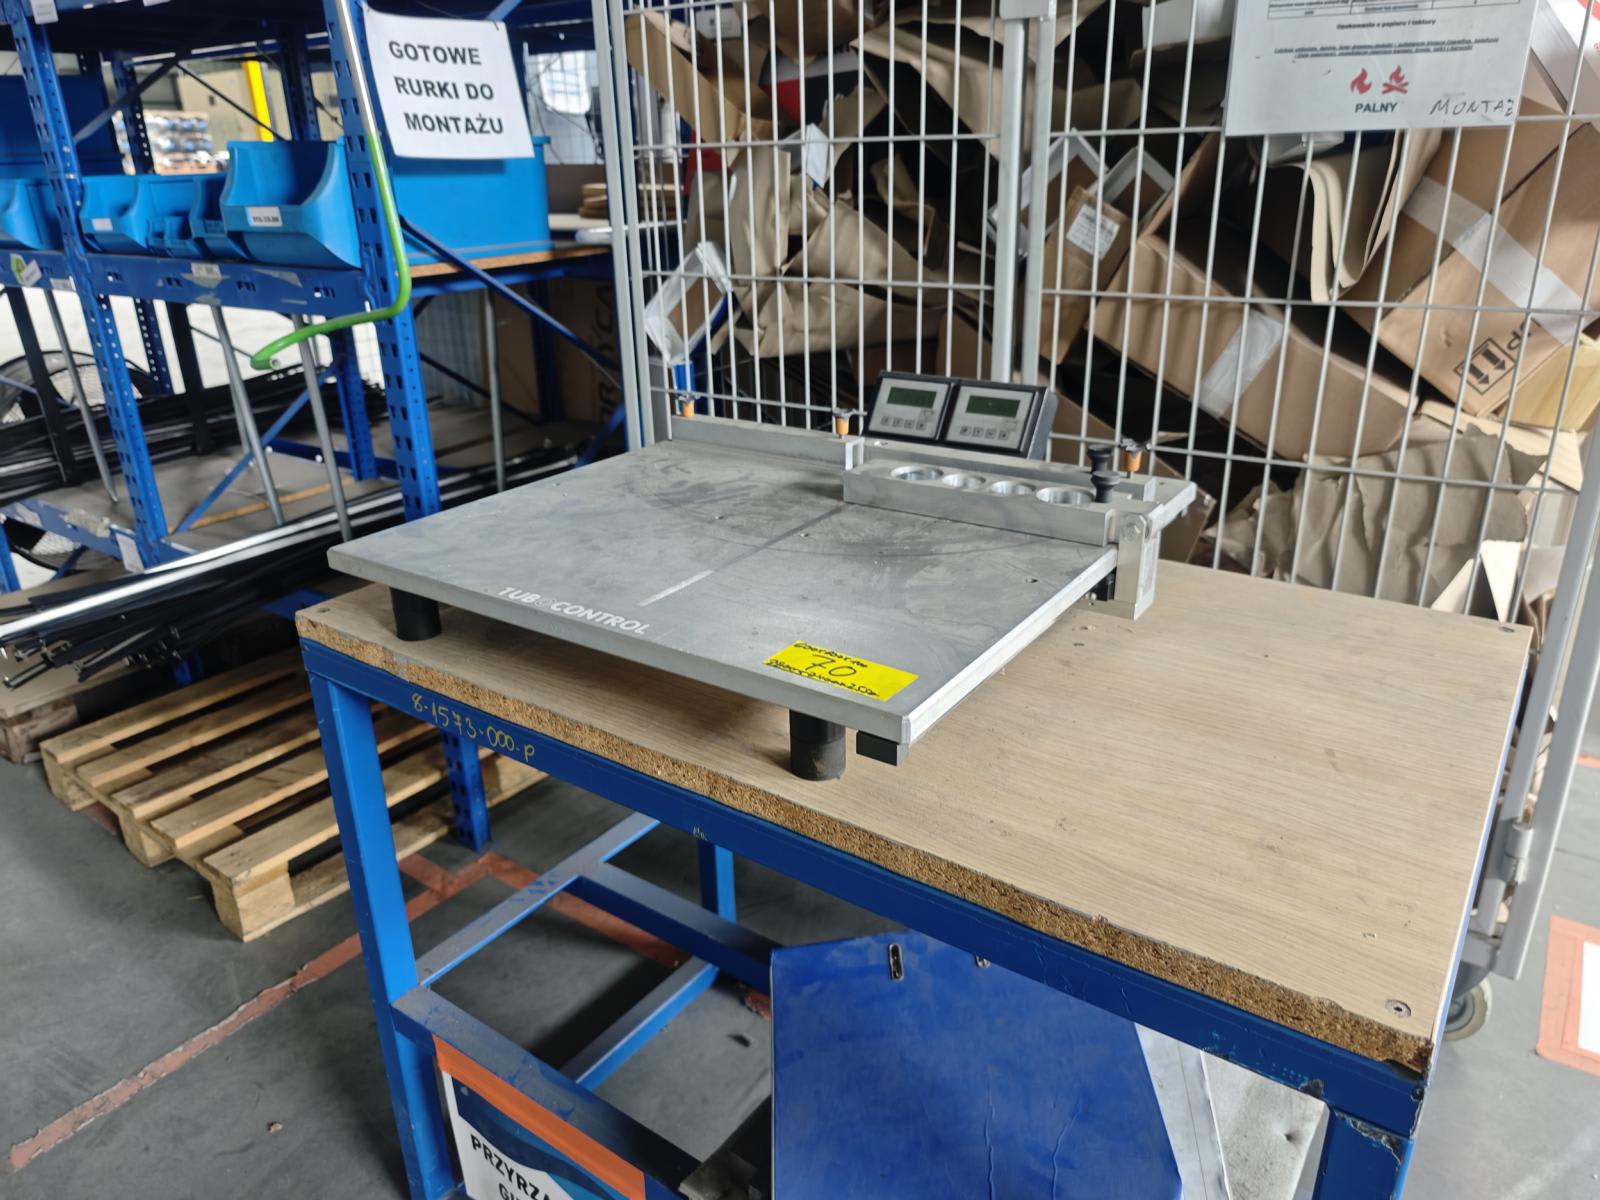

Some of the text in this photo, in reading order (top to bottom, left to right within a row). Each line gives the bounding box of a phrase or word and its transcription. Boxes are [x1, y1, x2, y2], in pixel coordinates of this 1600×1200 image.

[389, 40, 482, 66] GOTOWE
[394, 76, 494, 100] RURKI DO
[1354, 102, 1397, 114] PALNY
[404, 112, 504, 134] MONTAŻU
[805, 654, 857, 677] 70
